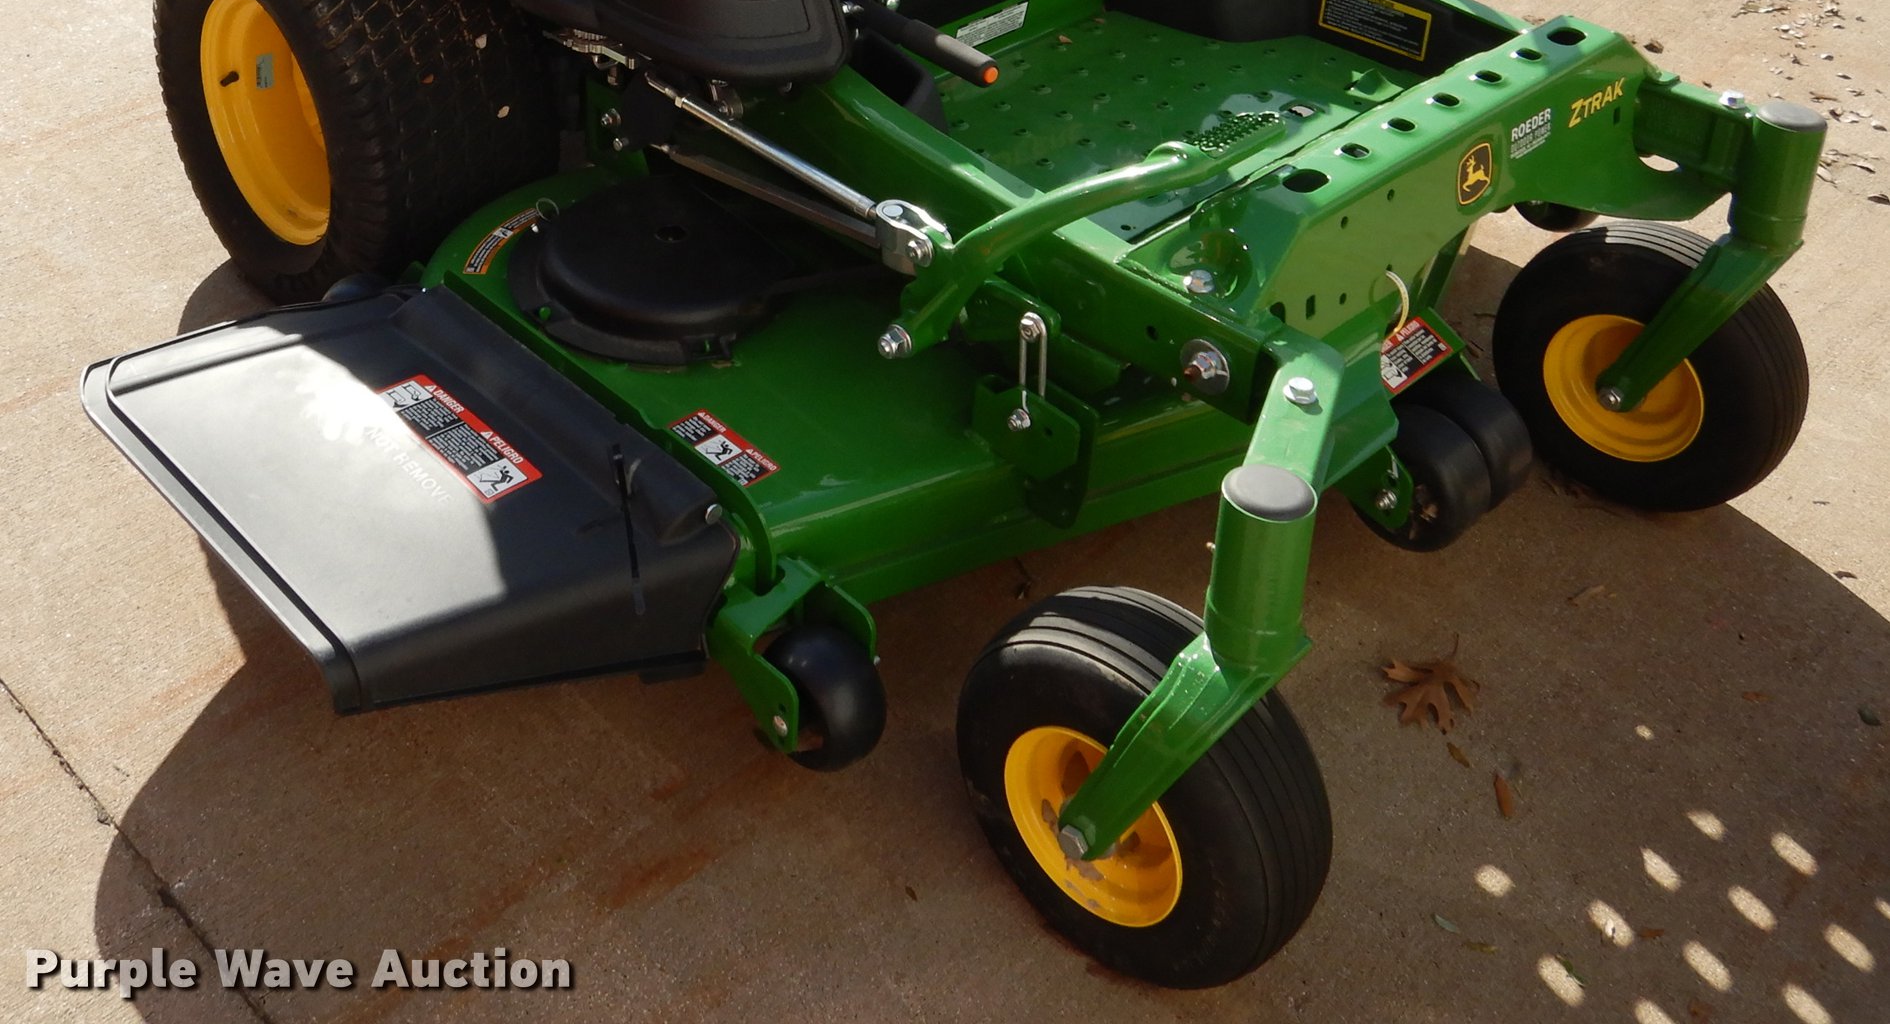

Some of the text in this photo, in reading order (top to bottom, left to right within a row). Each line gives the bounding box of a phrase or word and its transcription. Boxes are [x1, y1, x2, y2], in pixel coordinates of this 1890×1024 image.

[1568, 77, 1626, 128] ZTRAK
[1511, 107, 1551, 142] ROEDER
[433, 389, 465, 414] DANGER
[489, 435, 524, 464] PELIGRO
[393, 451, 455, 506] REMOVE
